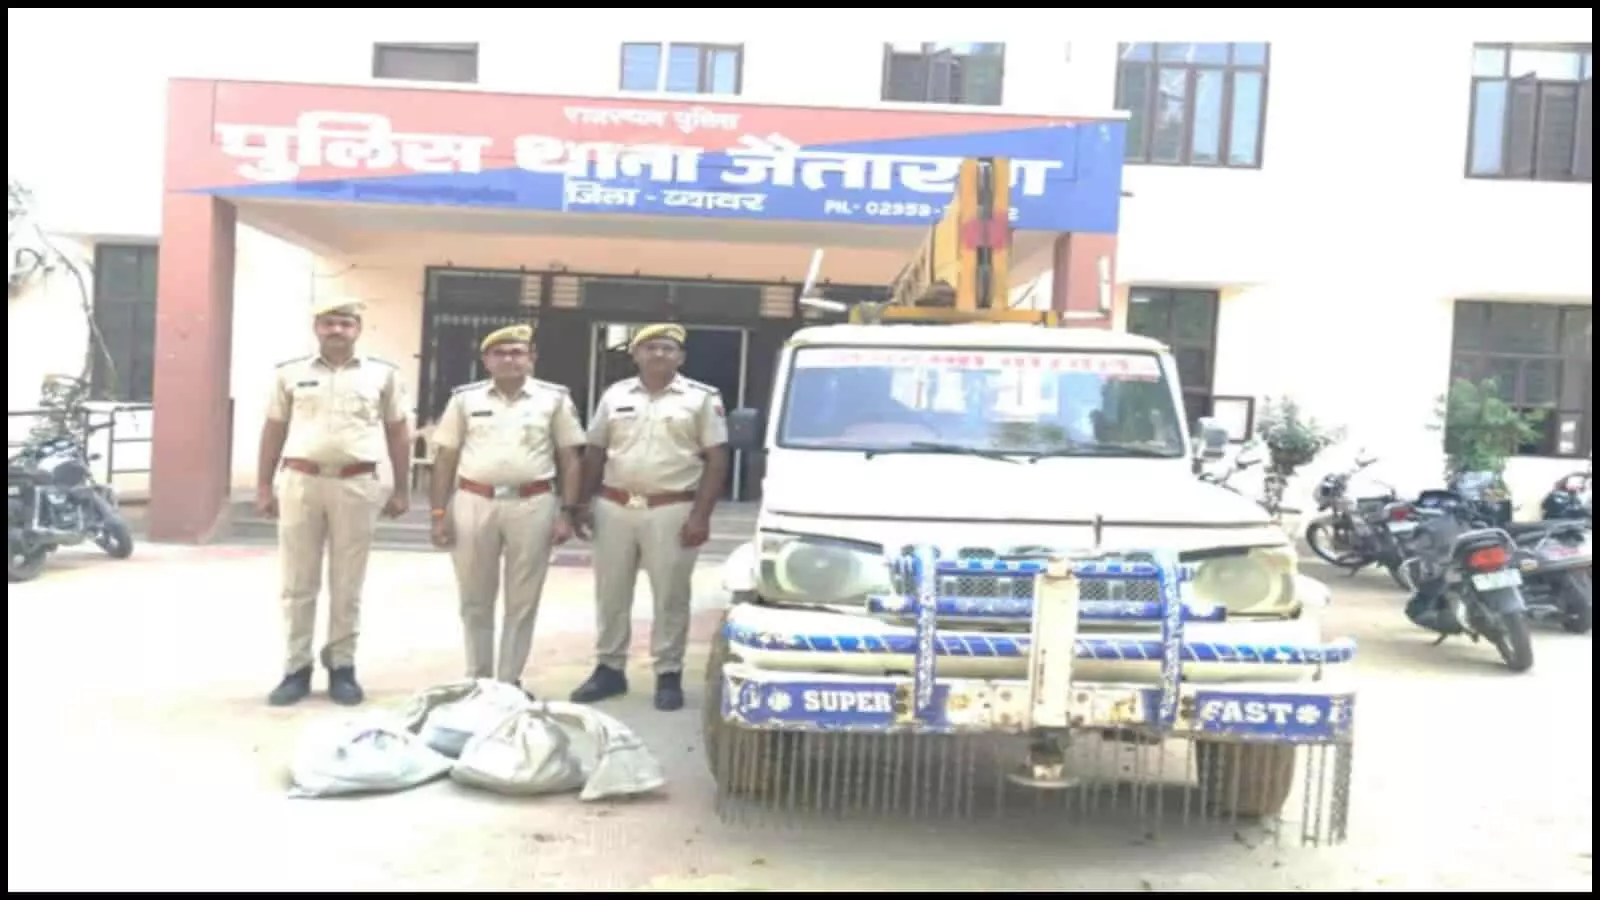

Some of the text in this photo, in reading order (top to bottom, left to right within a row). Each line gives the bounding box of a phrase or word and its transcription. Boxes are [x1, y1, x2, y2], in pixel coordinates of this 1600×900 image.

[214, 110, 494, 182] पुलिस
[513, 134, 705, 183] थाना
[566, 180, 640, 206] जिला
[802, 689, 1294, 725] SUPER FAST
